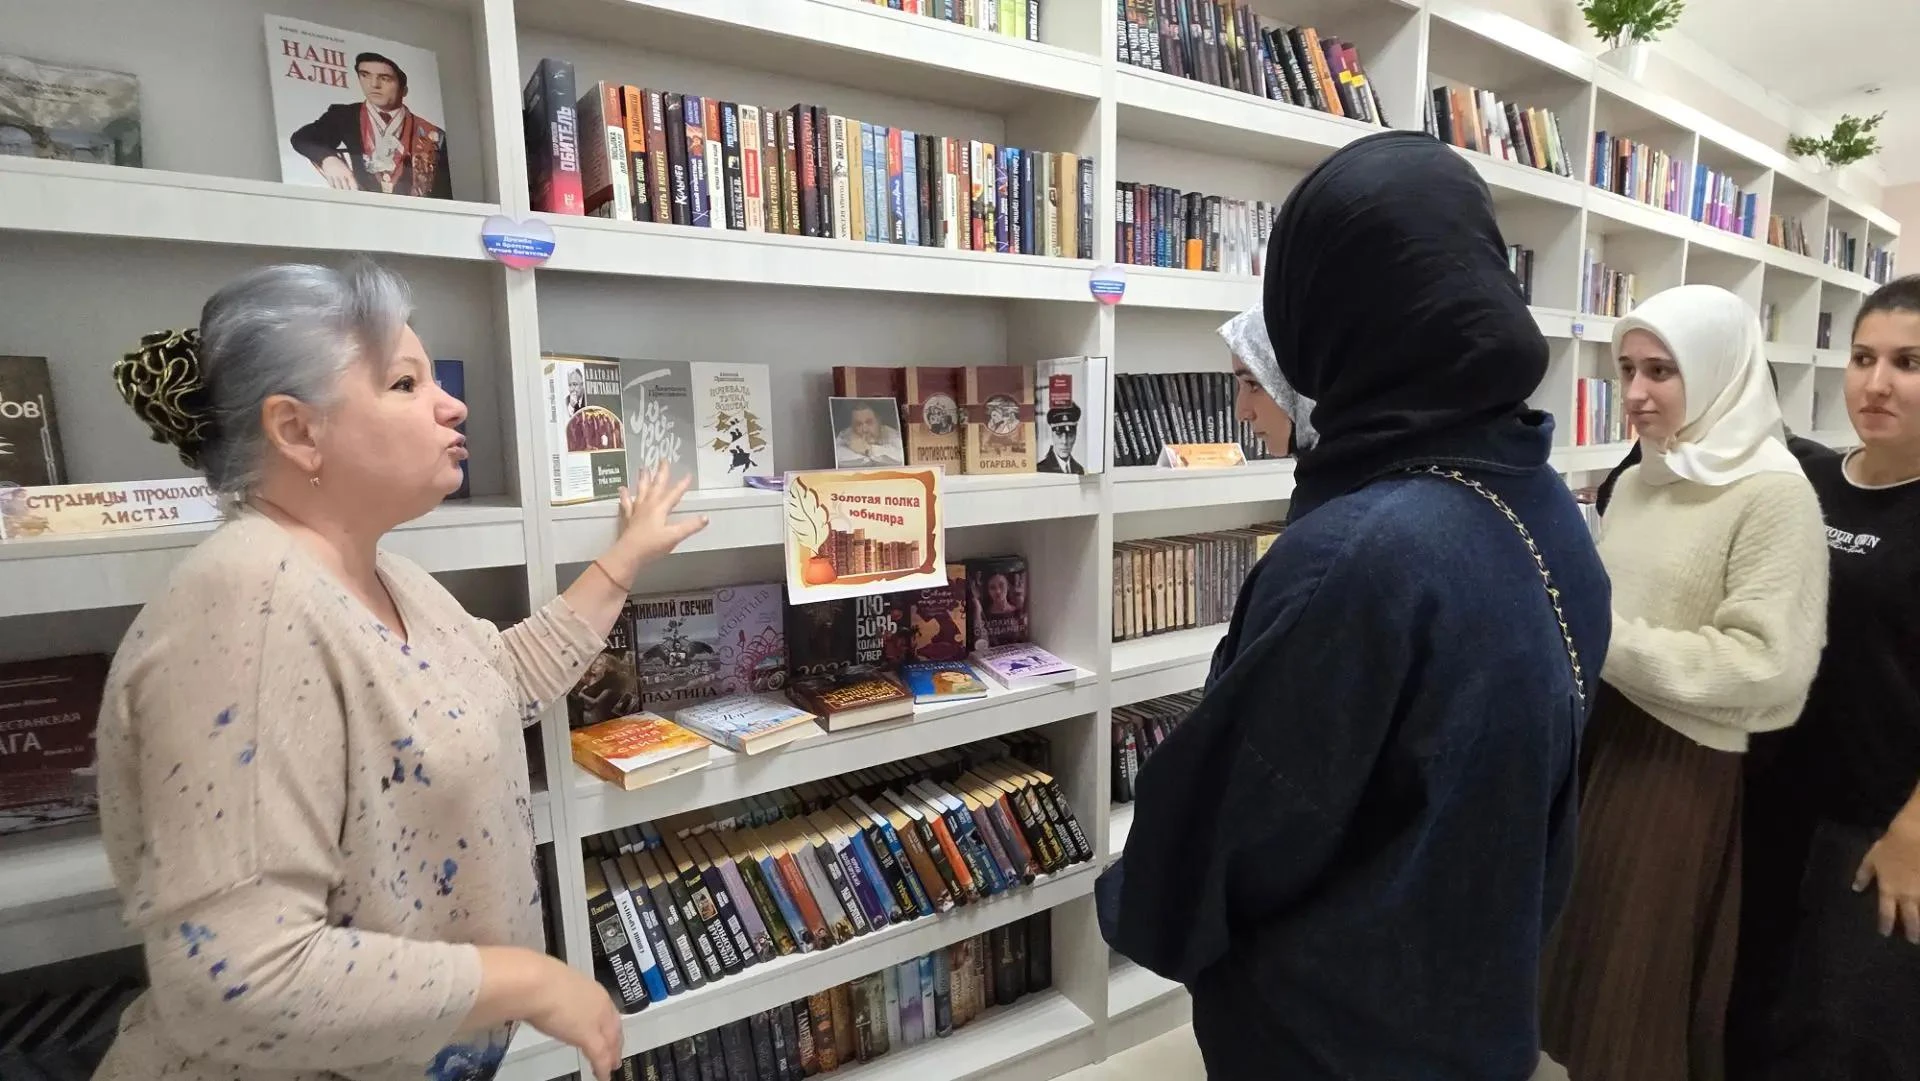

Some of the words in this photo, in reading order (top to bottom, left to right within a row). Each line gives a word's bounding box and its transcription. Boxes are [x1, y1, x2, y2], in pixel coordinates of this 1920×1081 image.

[1118, 20, 1128, 46] ЧАЙЛД
[1129, 23, 1139, 48] ЧАЙЛД
[1139, 28, 1149, 54] ЧАЙЛД
[1150, 33, 1160, 58] ЧАЙЛД
[281, 39, 347, 67] НАШ
[285, 60, 350, 89] АЛИ
[651, 92, 661, 124] ШАРАПОВ
[557, 106, 577, 172] ОБИТЕЛЬ
[656, 150, 667, 186] КОНВЕРТЕ
[660, 193, 669, 219] СМЕРТЬ
[26, 491, 127, 512] СТРАНИЦЫ
[830, 492, 882, 505] Золотая
[884, 494, 921, 508] полка
[101, 506, 180, 526] ЛИСТАЯ
[849, 508, 905, 527] юбиляра
[680, 599, 715, 617] СВЕЧИН
[856, 614, 898, 638] БОВЬ
[641, 686, 719, 704] ПАУТИНА
[707, 923, 731, 966] НИКОЛАЙ
[712, 918, 737, 963] ЗАДОРНОВ
[609, 954, 636, 1003] АНАТОЛИЙ
[623, 960, 645, 998] ИВАНОВ
